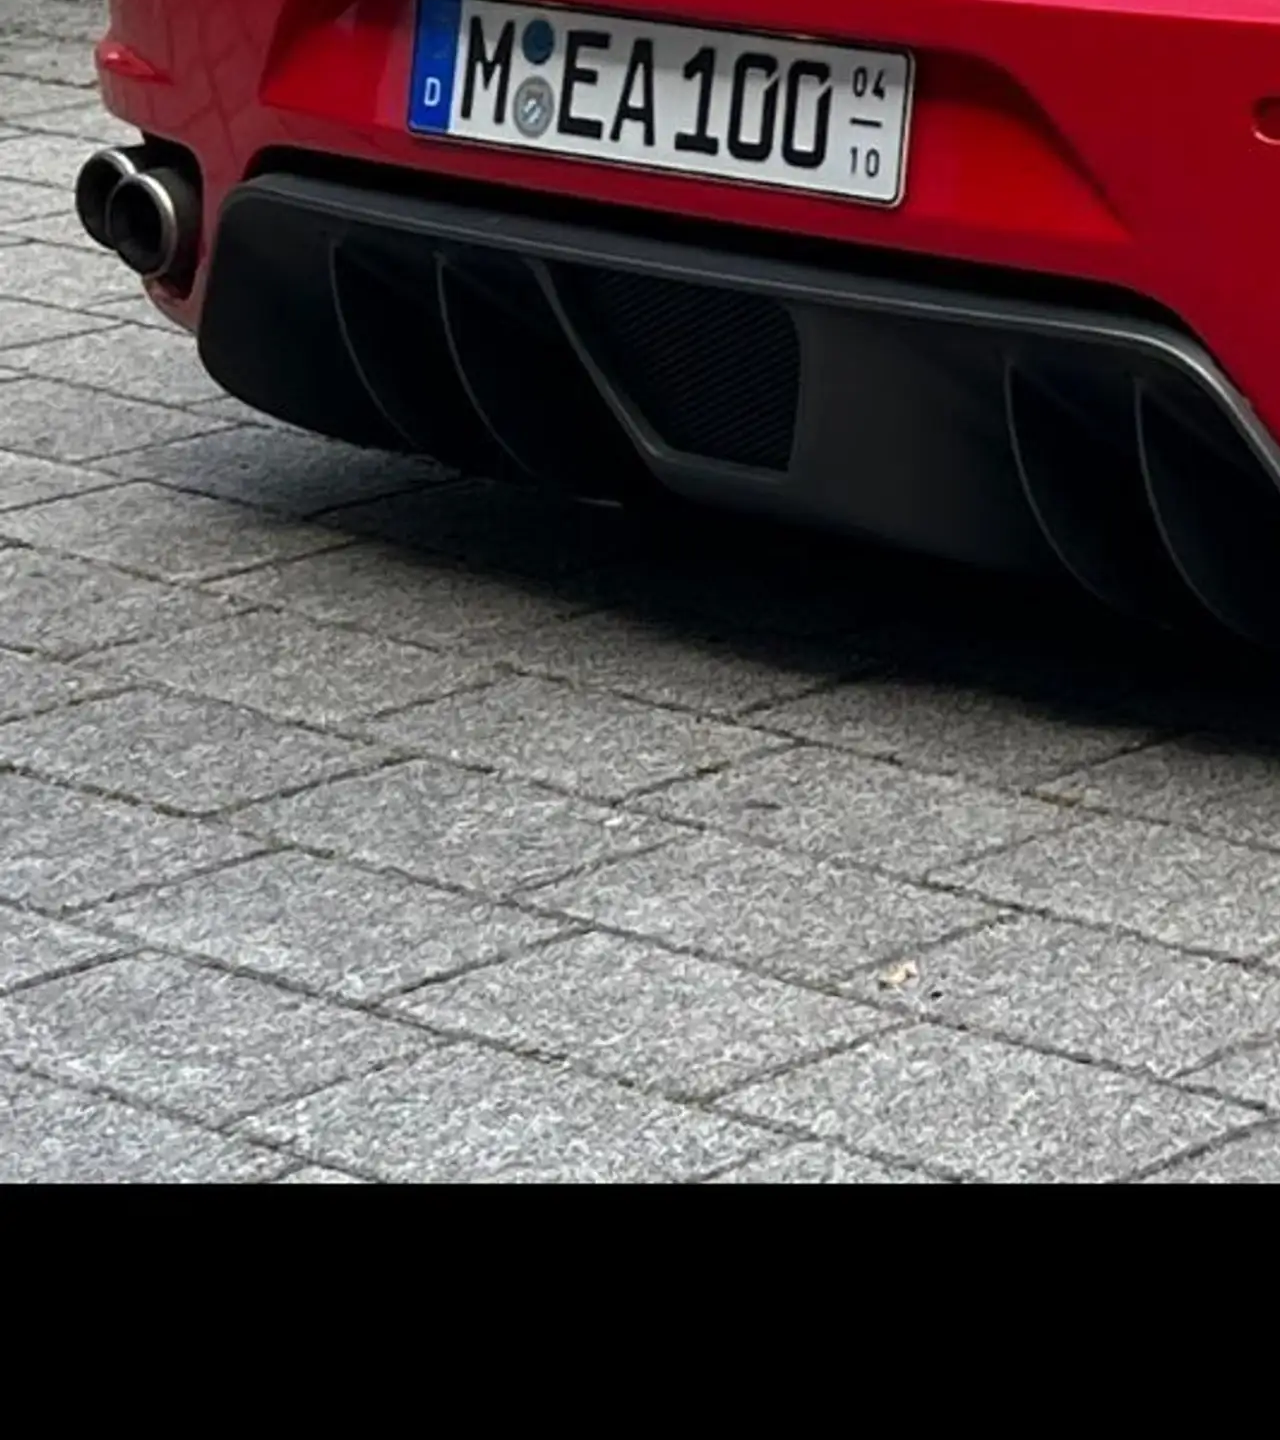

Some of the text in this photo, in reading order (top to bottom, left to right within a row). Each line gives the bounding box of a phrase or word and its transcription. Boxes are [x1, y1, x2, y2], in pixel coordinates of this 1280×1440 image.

[423, 77, 440, 107] D
[853, 67, 886, 101] 04
[849, 146, 881, 179] 10
